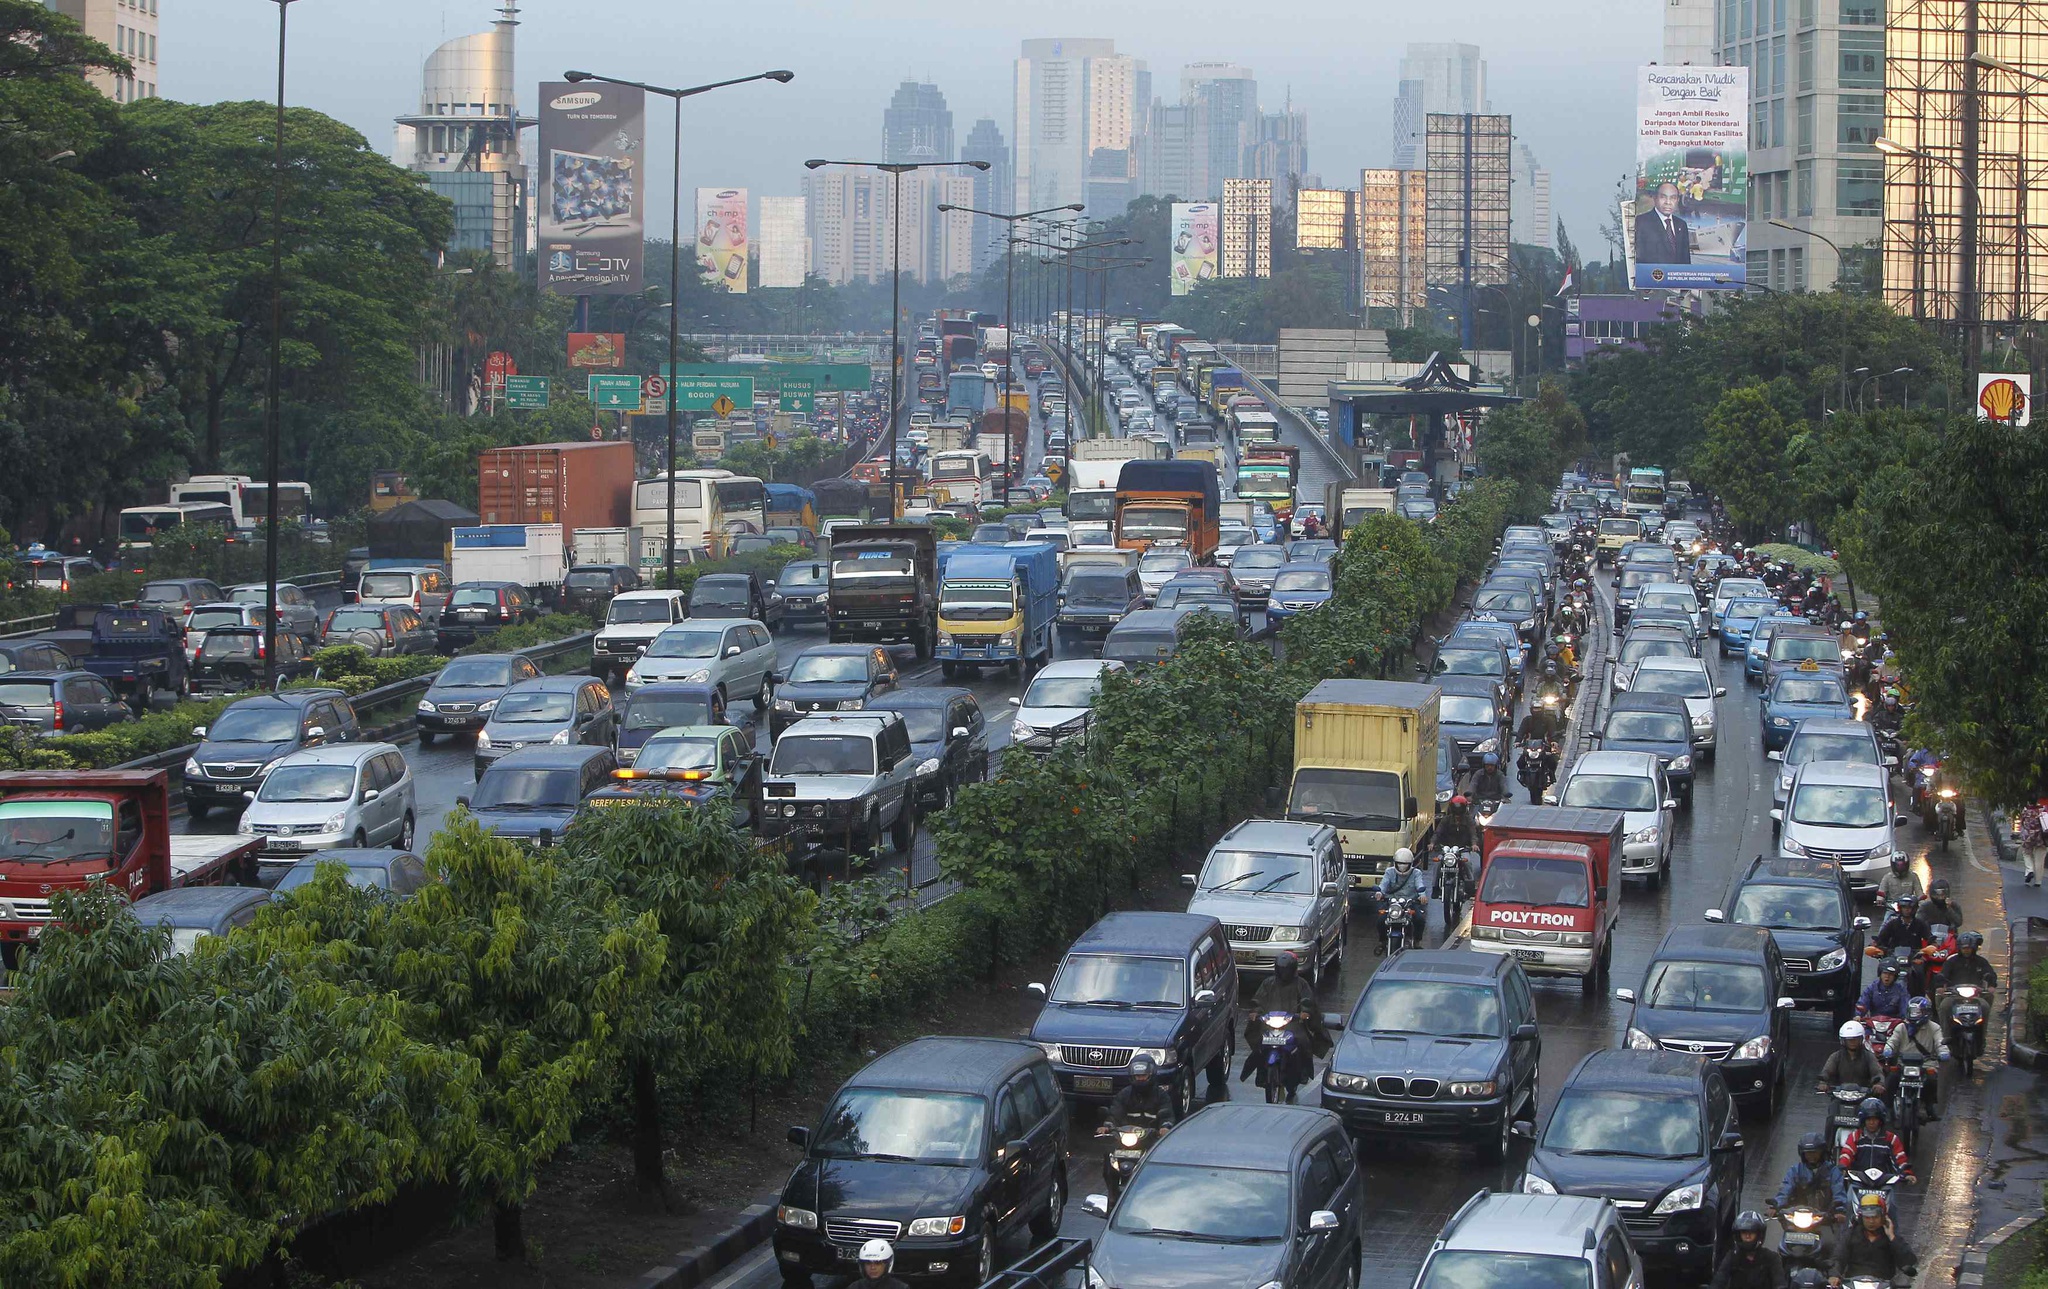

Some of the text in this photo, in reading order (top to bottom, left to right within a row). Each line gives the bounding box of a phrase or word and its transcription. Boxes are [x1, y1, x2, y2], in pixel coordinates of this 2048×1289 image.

[1648, 73, 1736, 84] Rencanakan Mudik
[1661, 86, 1721, 100] Dengan Baik
[556, 97, 596, 105] SAMSUNG
[1654, 110, 1680, 118] Jangan
[1659, 139, 1702, 147] Pengangkut
[612, 258, 630, 271] TV
[612, 273, 619, 281] in
[648, 547, 655, 557] 11
[353, 639, 374, 650] HONDA
[128, 868, 144, 890] PLUS
[1490, 910, 1575, 927] POLYTRON
[1511, 949, 1516, 957] B
[1517, 950, 1534, 958] 9342
[1385, 1112, 1424, 1122] B 274 EN
[837, 1247, 844, 1259] B
